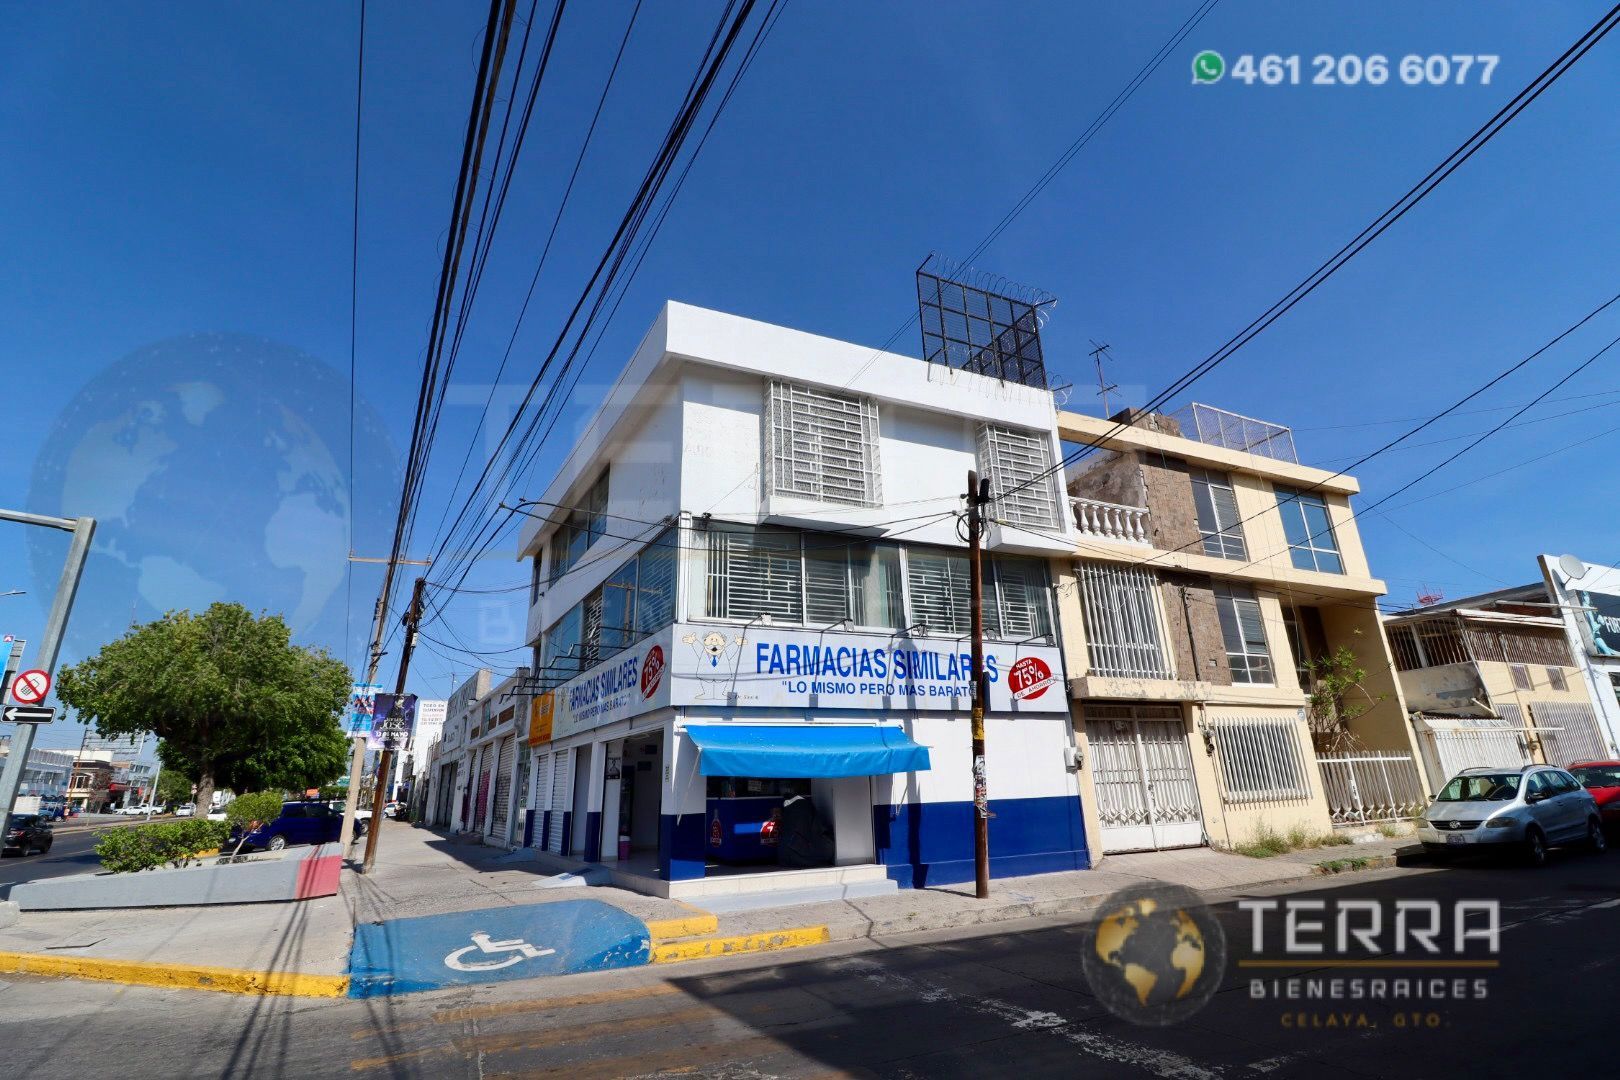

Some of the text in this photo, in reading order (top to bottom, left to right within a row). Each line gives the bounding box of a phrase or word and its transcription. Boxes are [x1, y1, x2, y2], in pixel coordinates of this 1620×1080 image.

[756, 643, 999, 683] FARMACIAS SIMILARS
[1013, 662, 1044, 689] 75%
[1015, 659, 1032, 670] HASTA
[600, 656, 638, 699] SIMILARES
[812, 681, 856, 695] MISMO
[860, 683, 894, 696] PERO
[900, 684, 926, 697] MAS
[930, 685, 973, 698] BARAT
